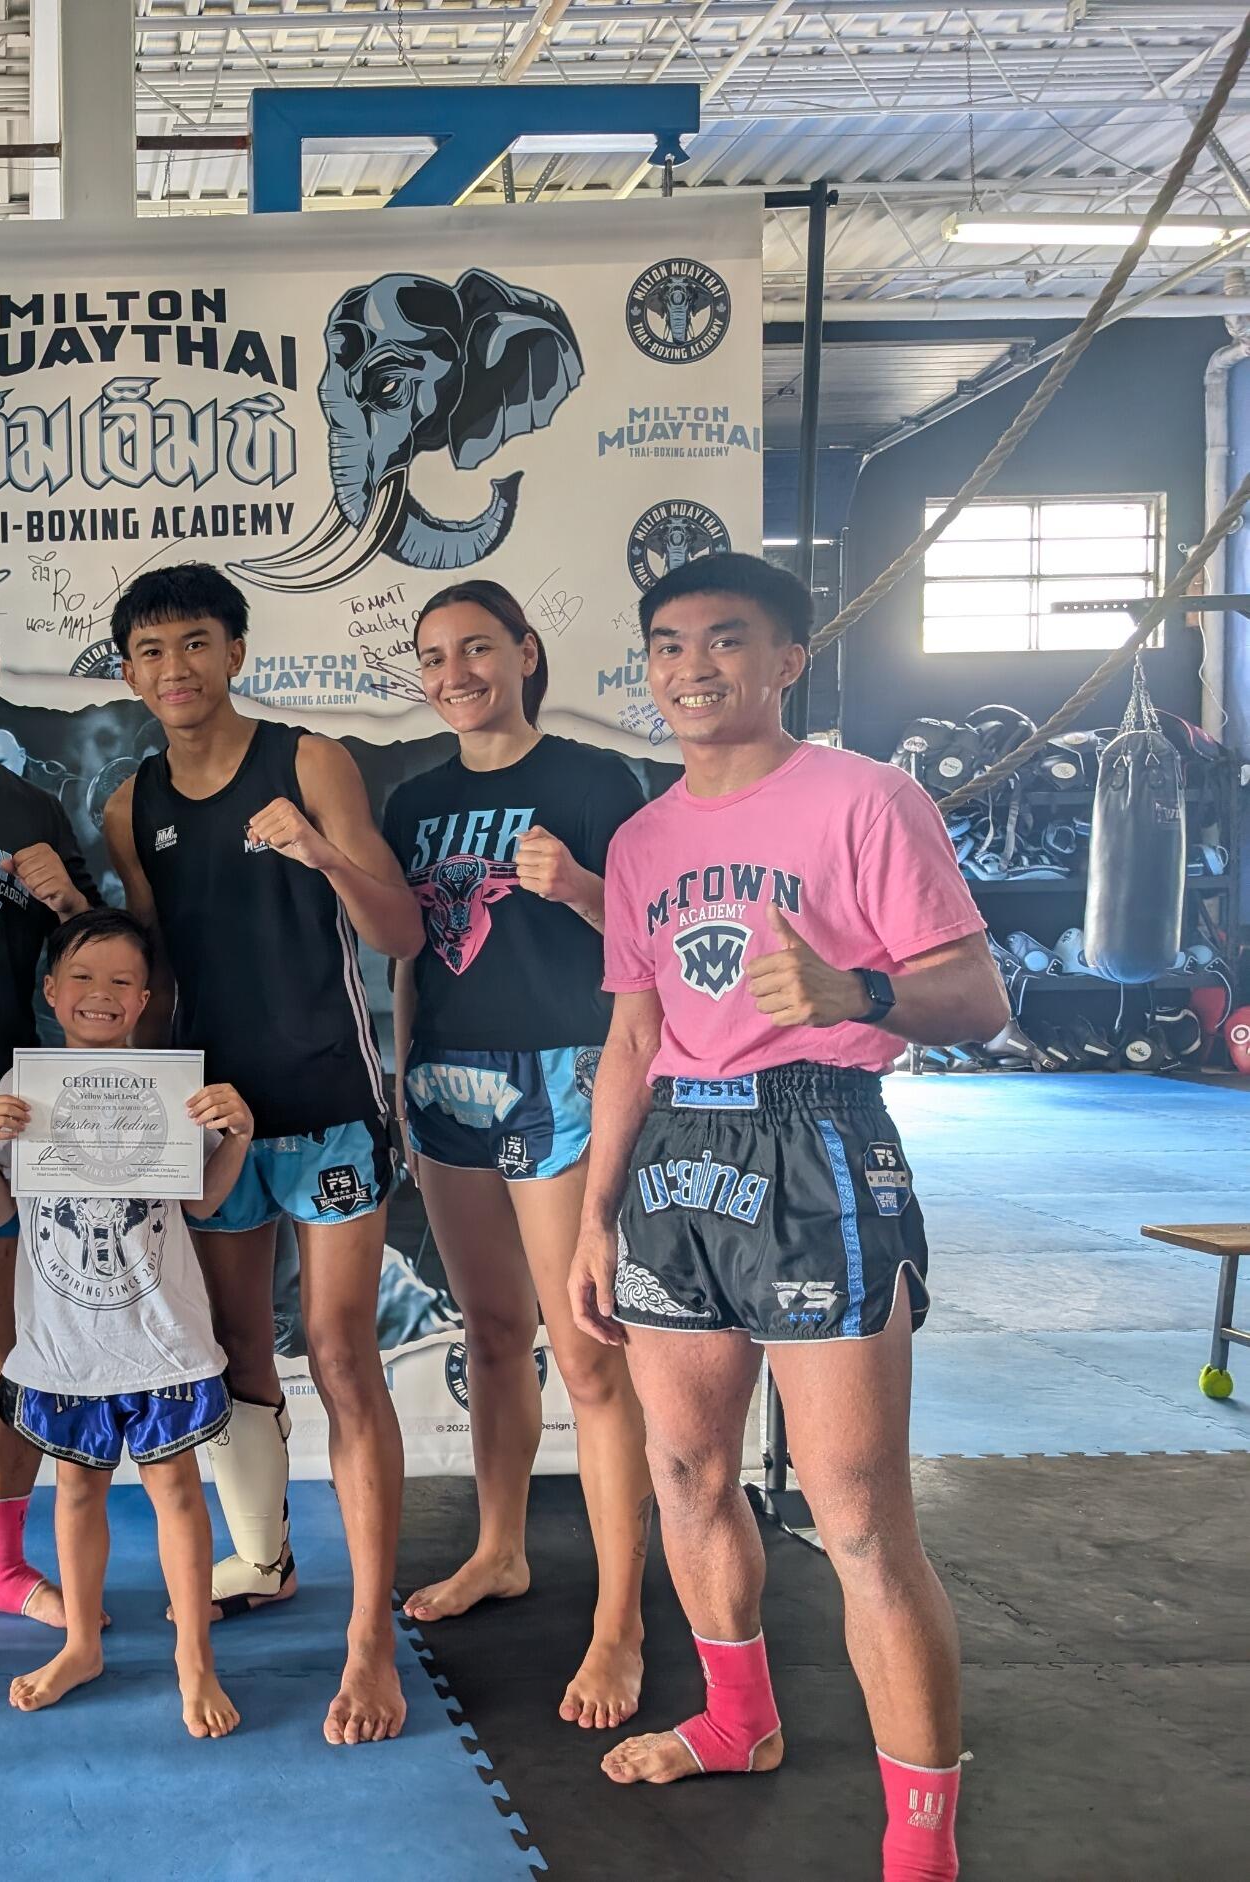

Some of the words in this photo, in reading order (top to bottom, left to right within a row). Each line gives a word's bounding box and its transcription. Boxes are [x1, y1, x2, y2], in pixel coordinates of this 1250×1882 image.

[632, 264, 668, 301] MILTON
[671, 262, 725, 298] MUAYTHAI
[0, 288, 228, 329] MILTON
[632, 322, 688, 359] THAI-BOXING
[690, 318, 725, 357] ACADEMY
[629, 406, 729, 423] MILTON
[598, 422, 761, 457] MUAYTHAI
[629, 447, 685, 458] THAI-BOXING
[687, 446, 730, 458] ACADEMY
[151, 502, 295, 539] ACADEMY
[633, 506, 668, 541] MILTON
[670, 503, 724, 539] MUAYTHAI
[255, 653, 357, 674] MILTON
[316, 692, 358, 706] ACADEMY
[647, 863, 803, 937] M-TOWN
[679, 903, 747, 927] ACADEMY
[62, 1076, 158, 1089] CERTIFICATE
[80, 1092, 102, 1100] Yellow
[103, 1092, 120, 1100] Shirt
[121, 1092, 139, 1100] Level
[103, 1114, 159, 1131] Medina
[326, 1175, 352, 1191] FS
[47, 1258, 102, 1298] INSPIRING
[108, 1277, 142, 1298] SINCE
[446, 1424, 470, 1432] 2022
